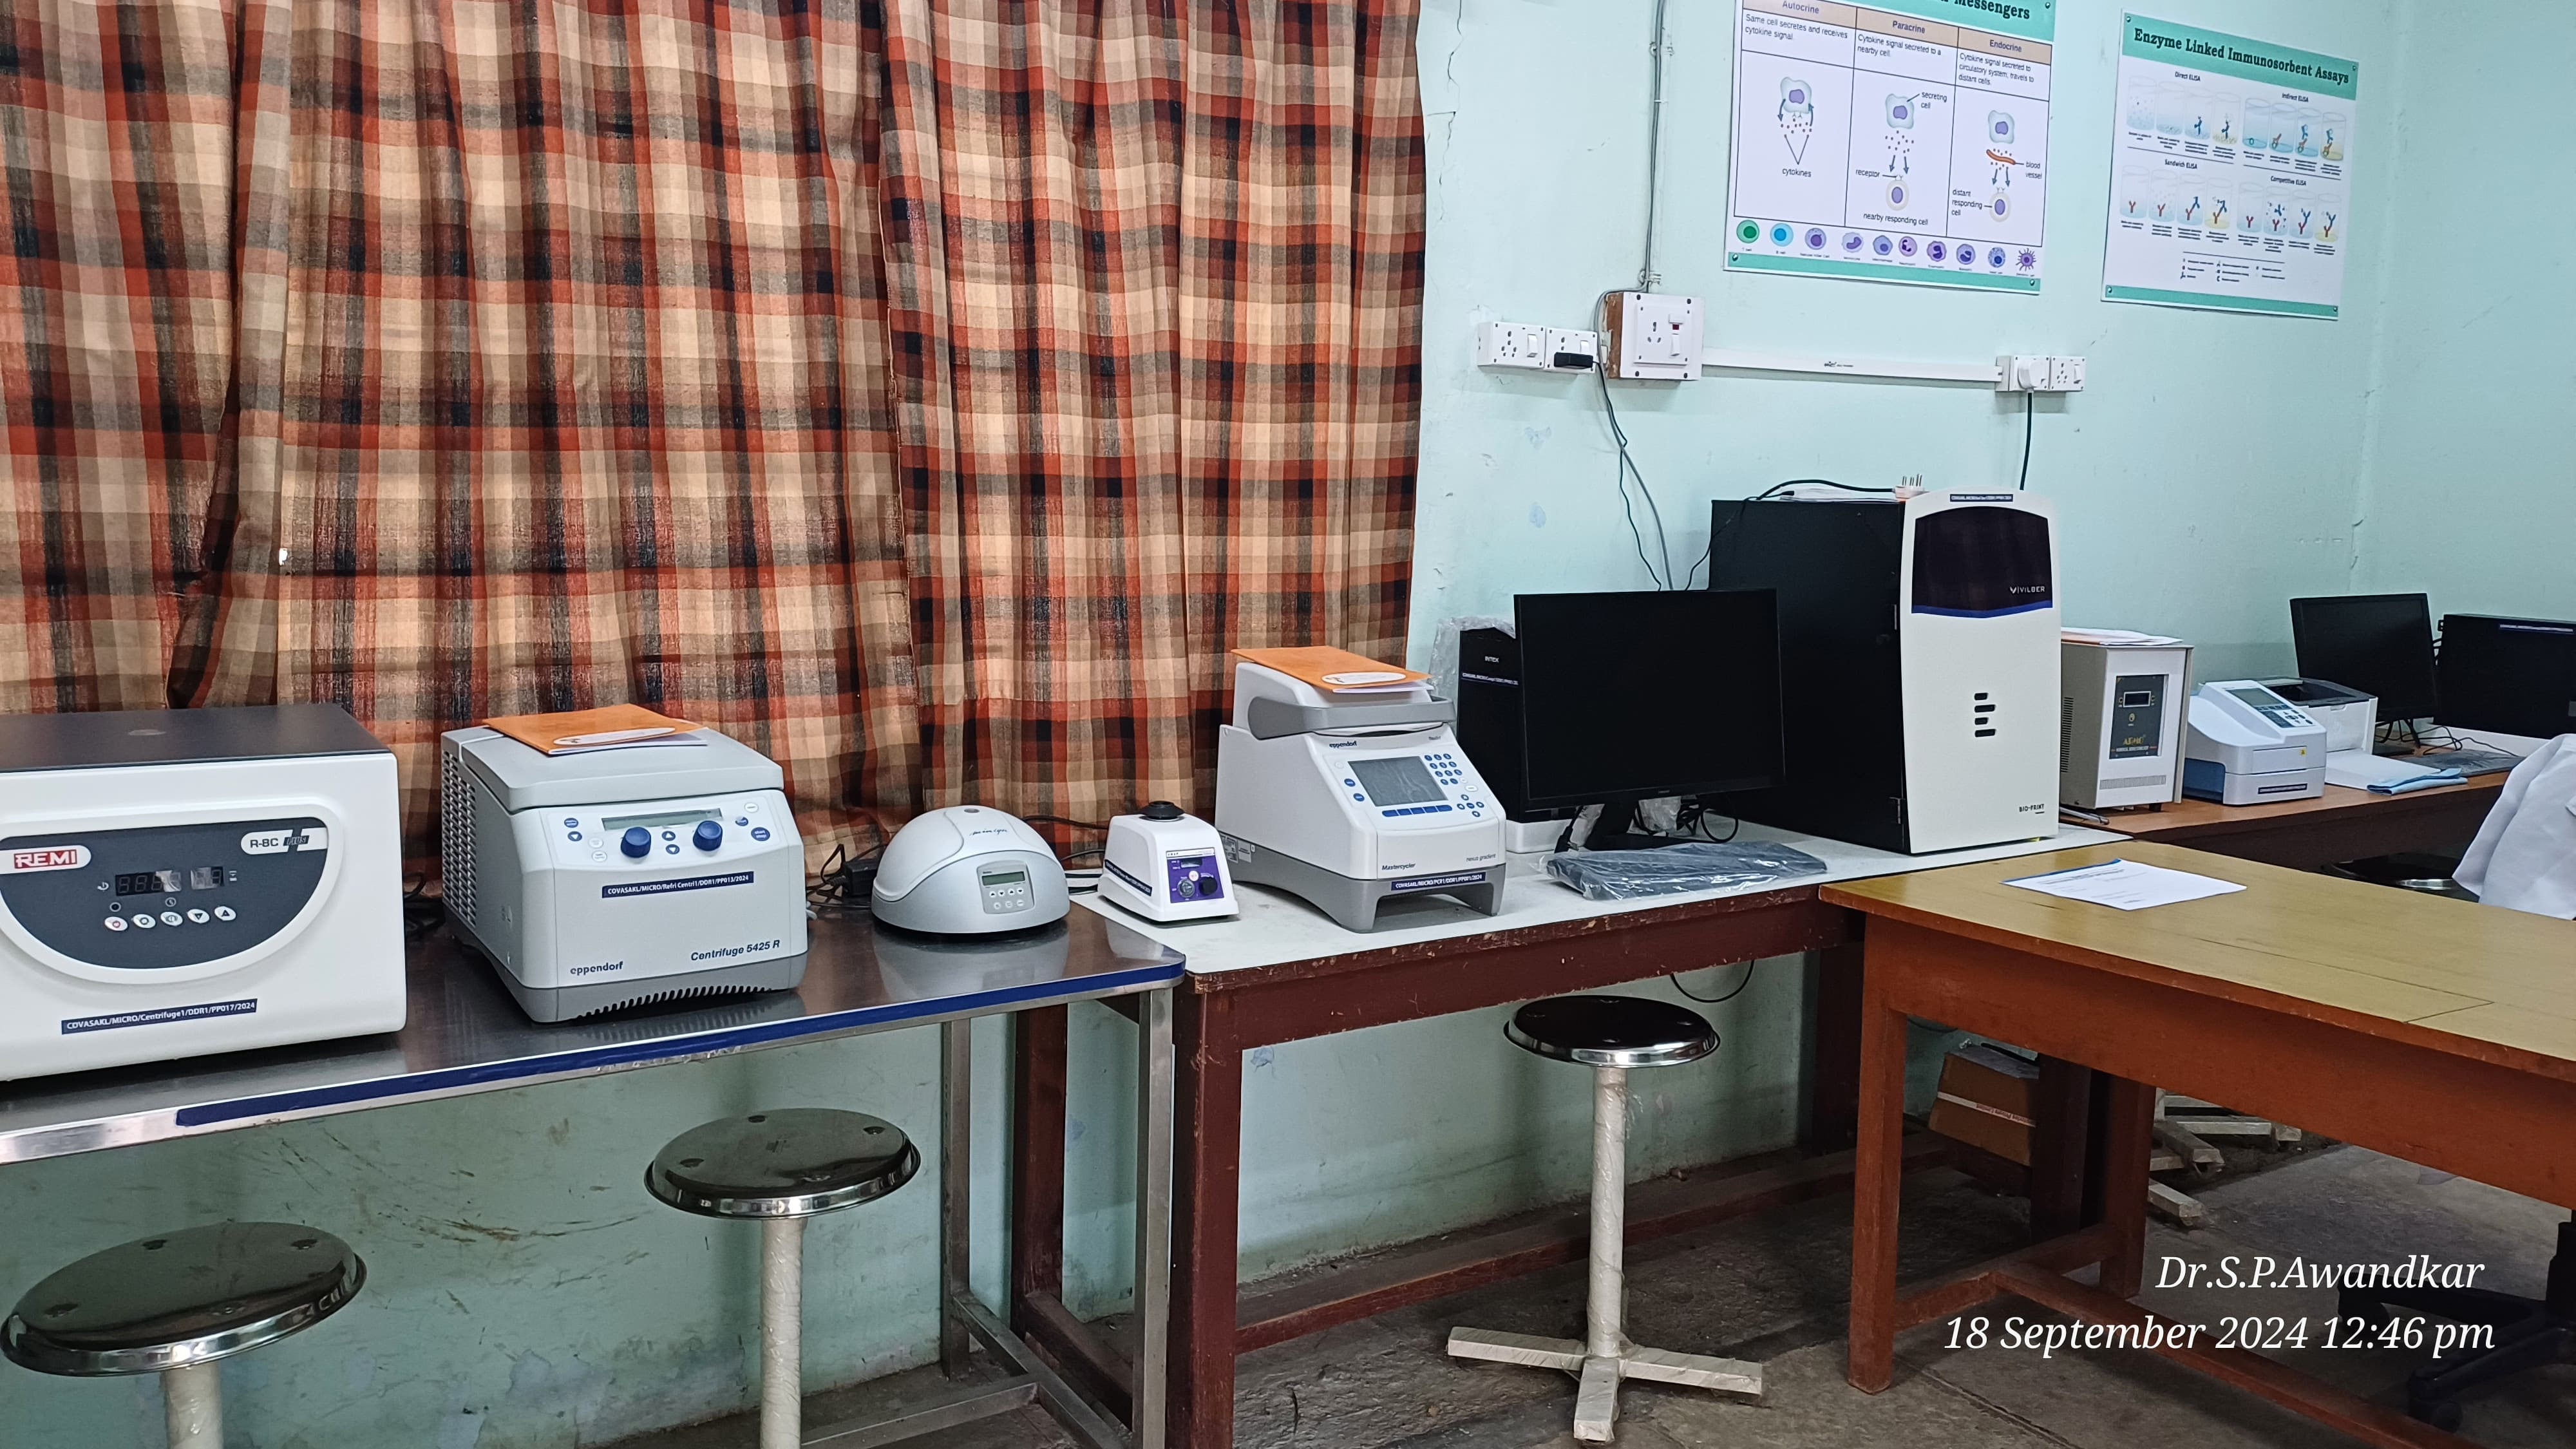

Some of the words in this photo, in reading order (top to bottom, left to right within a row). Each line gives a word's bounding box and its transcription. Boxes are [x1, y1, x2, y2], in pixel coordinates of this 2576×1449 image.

[1782, 1, 1819, 14] Autocrine
[1745, 26, 1772, 36] cytokine
[1746, 14, 1765, 24] Same
[1779, 21, 1806, 32] secretes
[1822, 28, 1848, 38] receives
[1892, 21, 1926, 33] Paracrine
[1858, 34, 1884, 44] Cytokine
[1886, 39, 1903, 48] signal
[1905, 44, 1929, 53] secreted
[1989, 39, 2022, 52] Endocrine
[1857, 46, 1878, 56] nearby
[2134, 27, 2182, 49] Enzyme
[2185, 38, 2224, 59] Linked
[2228, 47, 2313, 76] Immunosorbent
[2315, 66, 2349, 86] Assays
[1960, 52, 1984, 63] Cytokine
[1985, 58, 2001, 66] signal
[2002, 61, 2024, 70] secreted
[1958, 73, 1976, 82] distant
[1959, 64, 1987, 75] circulatory
[2010, 72, 2027, 81] travels
[2175, 71, 2188, 79] Direct
[1921, 91, 1947, 103] secreting
[2282, 92, 2298, 101] Indirect
[1782, 168, 1812, 178] cytokines
[1952, 200, 1983, 210] responding
[1863, 213, 1884, 223] nearby
[1885, 216, 1917, 225] responding
[1329, 740, 1358, 748] eppendorf
[250, 837, 279, 848] R-8C
[15, 850, 77, 868] REMI
[1381, 862, 1416, 871] Mastercycler
[691, 947, 744, 961] Centrifuge
[746, 941, 771, 952] 5425
[772, 940, 781, 949] R
[570, 961, 623, 976] eppendorf
